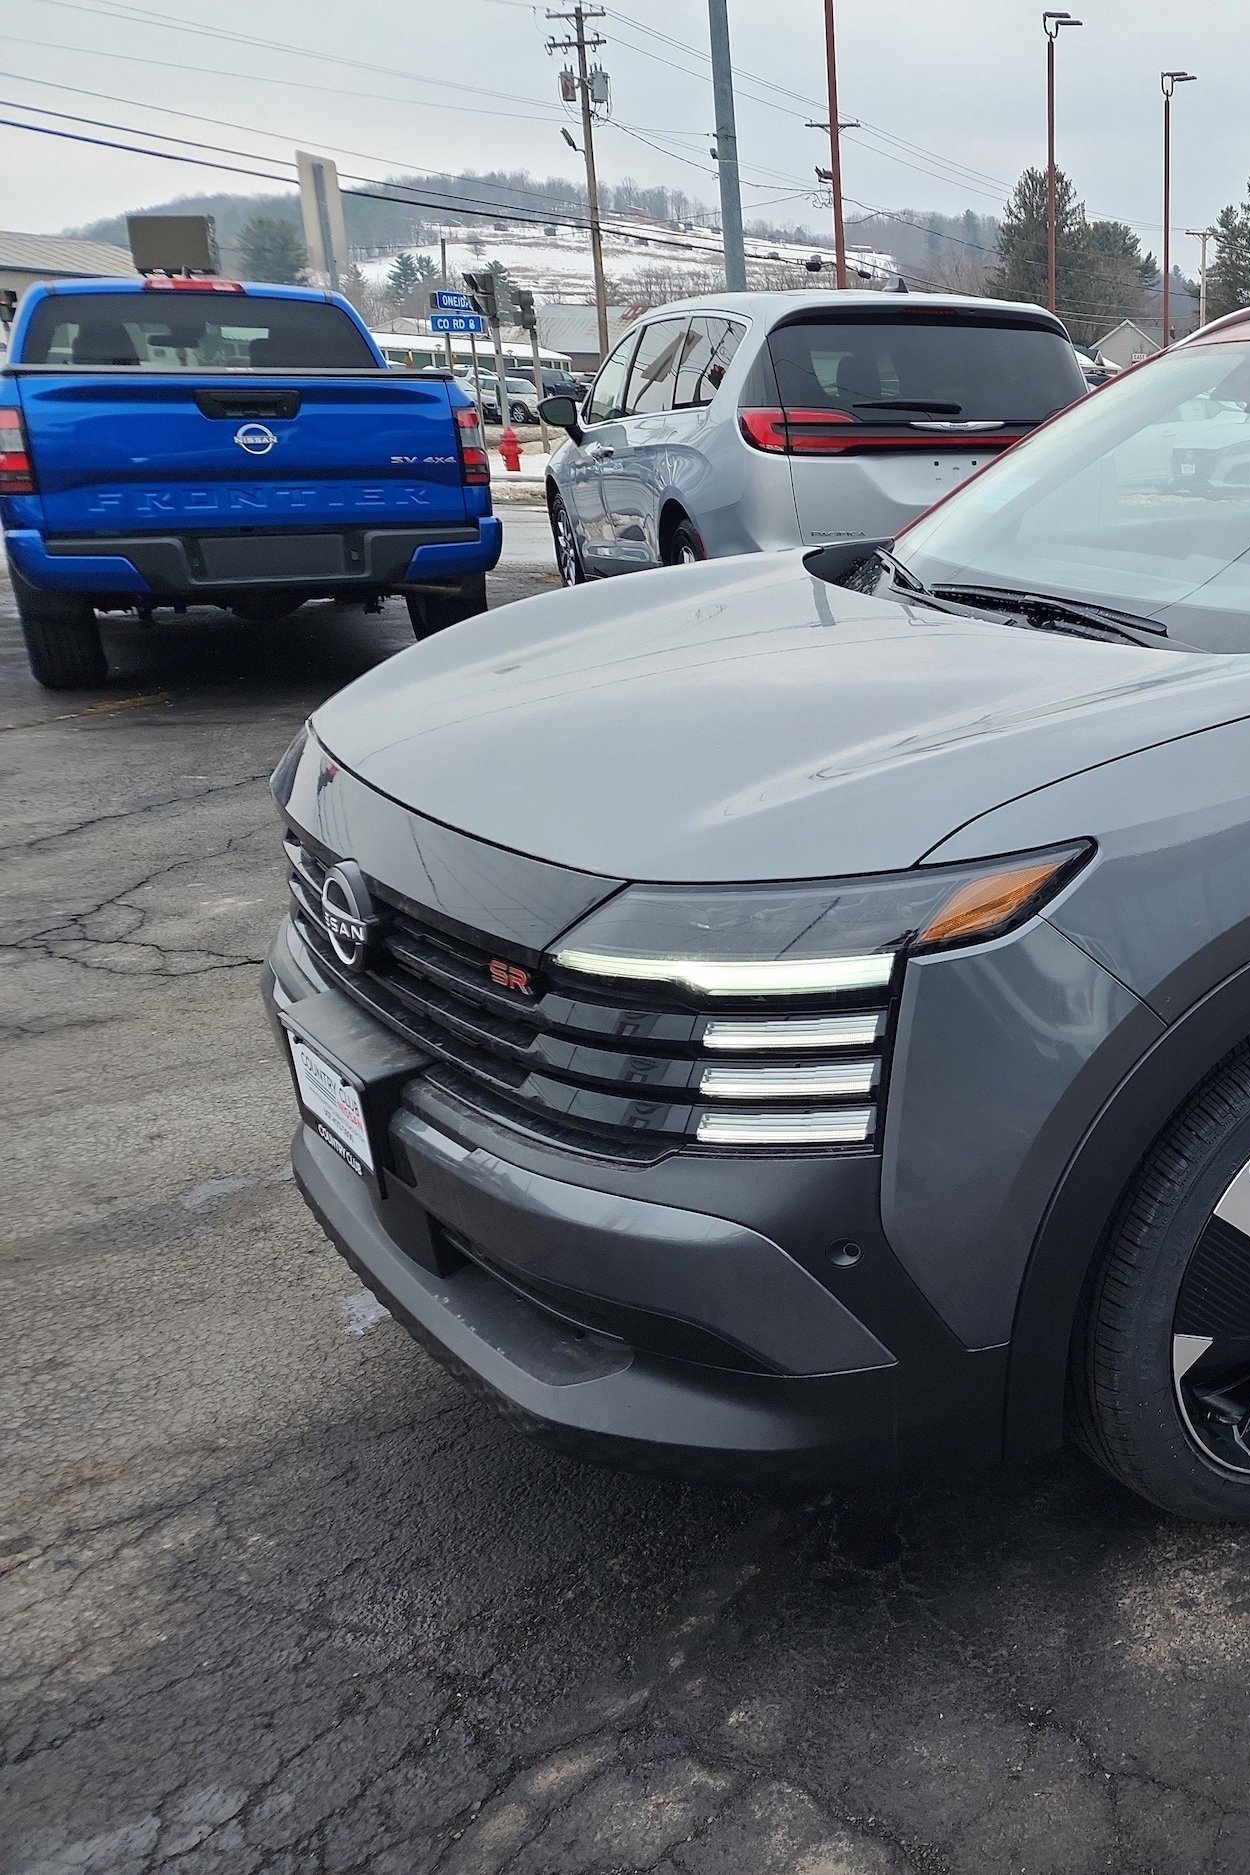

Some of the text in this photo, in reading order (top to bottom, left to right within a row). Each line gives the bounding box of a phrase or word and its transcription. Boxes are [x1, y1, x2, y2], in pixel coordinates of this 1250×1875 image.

[437, 318, 450, 330] CO
[453, 318, 465, 330] RD
[234, 436, 279, 444] NISSAN
[390, 456, 418, 464] SV
[88, 485, 430, 512] FRONTIER
[490, 959, 533, 996] SR
[300, 1051, 337, 1096] COUNTRY
[338, 1087, 360, 1117] CLUB
[345, 1151, 363, 1176] CLUB
